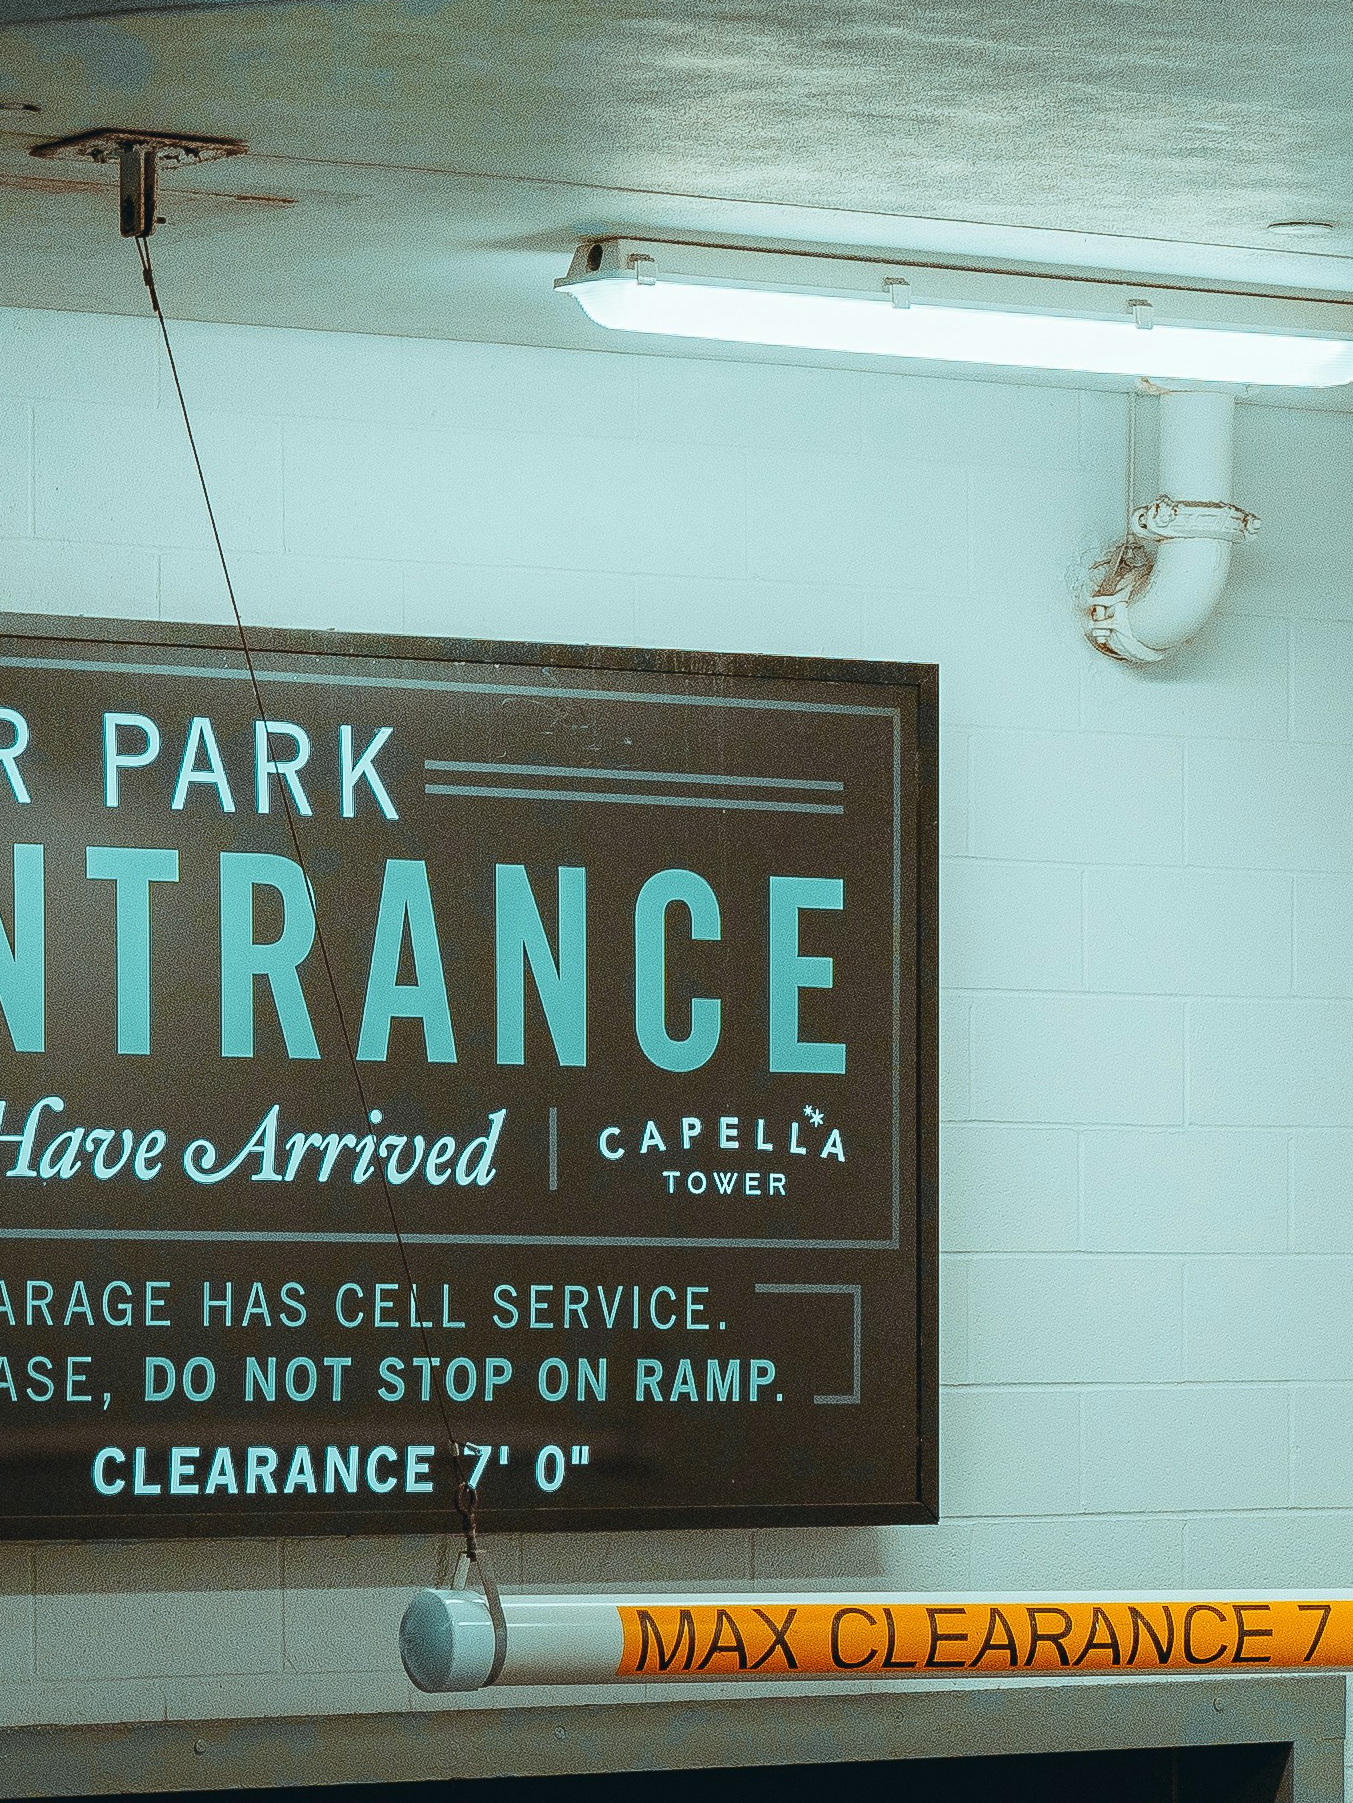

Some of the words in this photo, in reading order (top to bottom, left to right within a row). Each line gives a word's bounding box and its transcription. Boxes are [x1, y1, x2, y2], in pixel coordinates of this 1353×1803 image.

[104, 711, 400, 821] PARK
[183, 1104, 507, 1186] Arrived
[598, 1116, 845, 1162] CAPELLA
[662, 1171, 787, 1196] TOWER
[202, 1281, 308, 1328] HAS
[335, 1282, 466, 1329] CELL
[492, 1284, 727, 1332] SERVICE.
[145, 1356, 217, 1403] DO
[245, 1356, 352, 1403] NOT
[377, 1356, 513, 1403] STOP
[537, 1356, 608, 1403] ON
[635, 1357, 784, 1403] RAMP.
[91, 1445, 436, 1495] CLEARANCE
[463, 1442, 510, 1491] 7'
[534, 1444, 590, 1493] 0"
[635, 1606, 799, 1671] MAX
[831, 1603, 1274, 1670] CLEARANCE
[1297, 1603, 1332, 1663] 7
